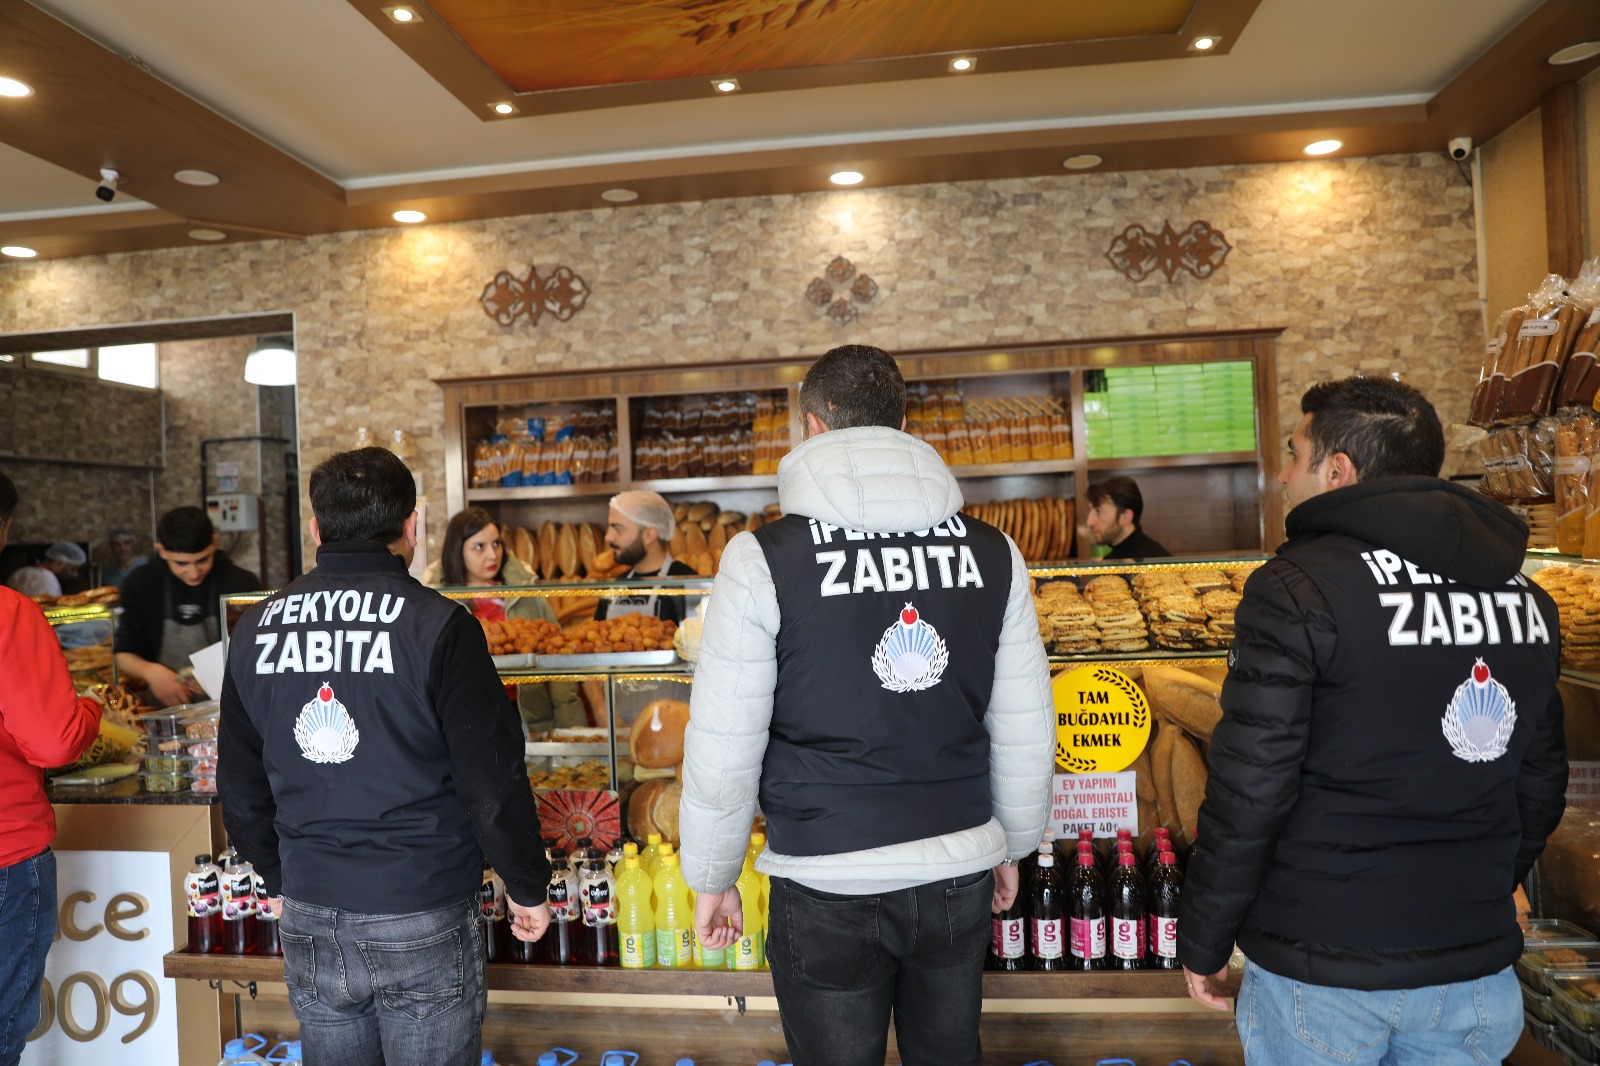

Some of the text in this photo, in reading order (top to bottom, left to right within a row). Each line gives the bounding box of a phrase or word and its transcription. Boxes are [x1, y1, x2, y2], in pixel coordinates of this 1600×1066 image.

[815, 545, 984, 597] ZABITA
[1378, 591, 1550, 646] ZABITA
[255, 629, 395, 675] ZABITA
[1077, 691, 1109, 704] TAM
[1058, 708, 1130, 726] BUĞDAYLI
[1073, 733, 1121, 747] EKMEK
[1062, 777, 1117, 790] EV YAPIMI
[1052, 792, 1133, 806] İFT YUMURTALI
[1054, 806, 1128, 820] DOĞAL ERİŞTE
[1063, 822, 1096, 834] PAKET
[53, 890, 151, 942] ce
